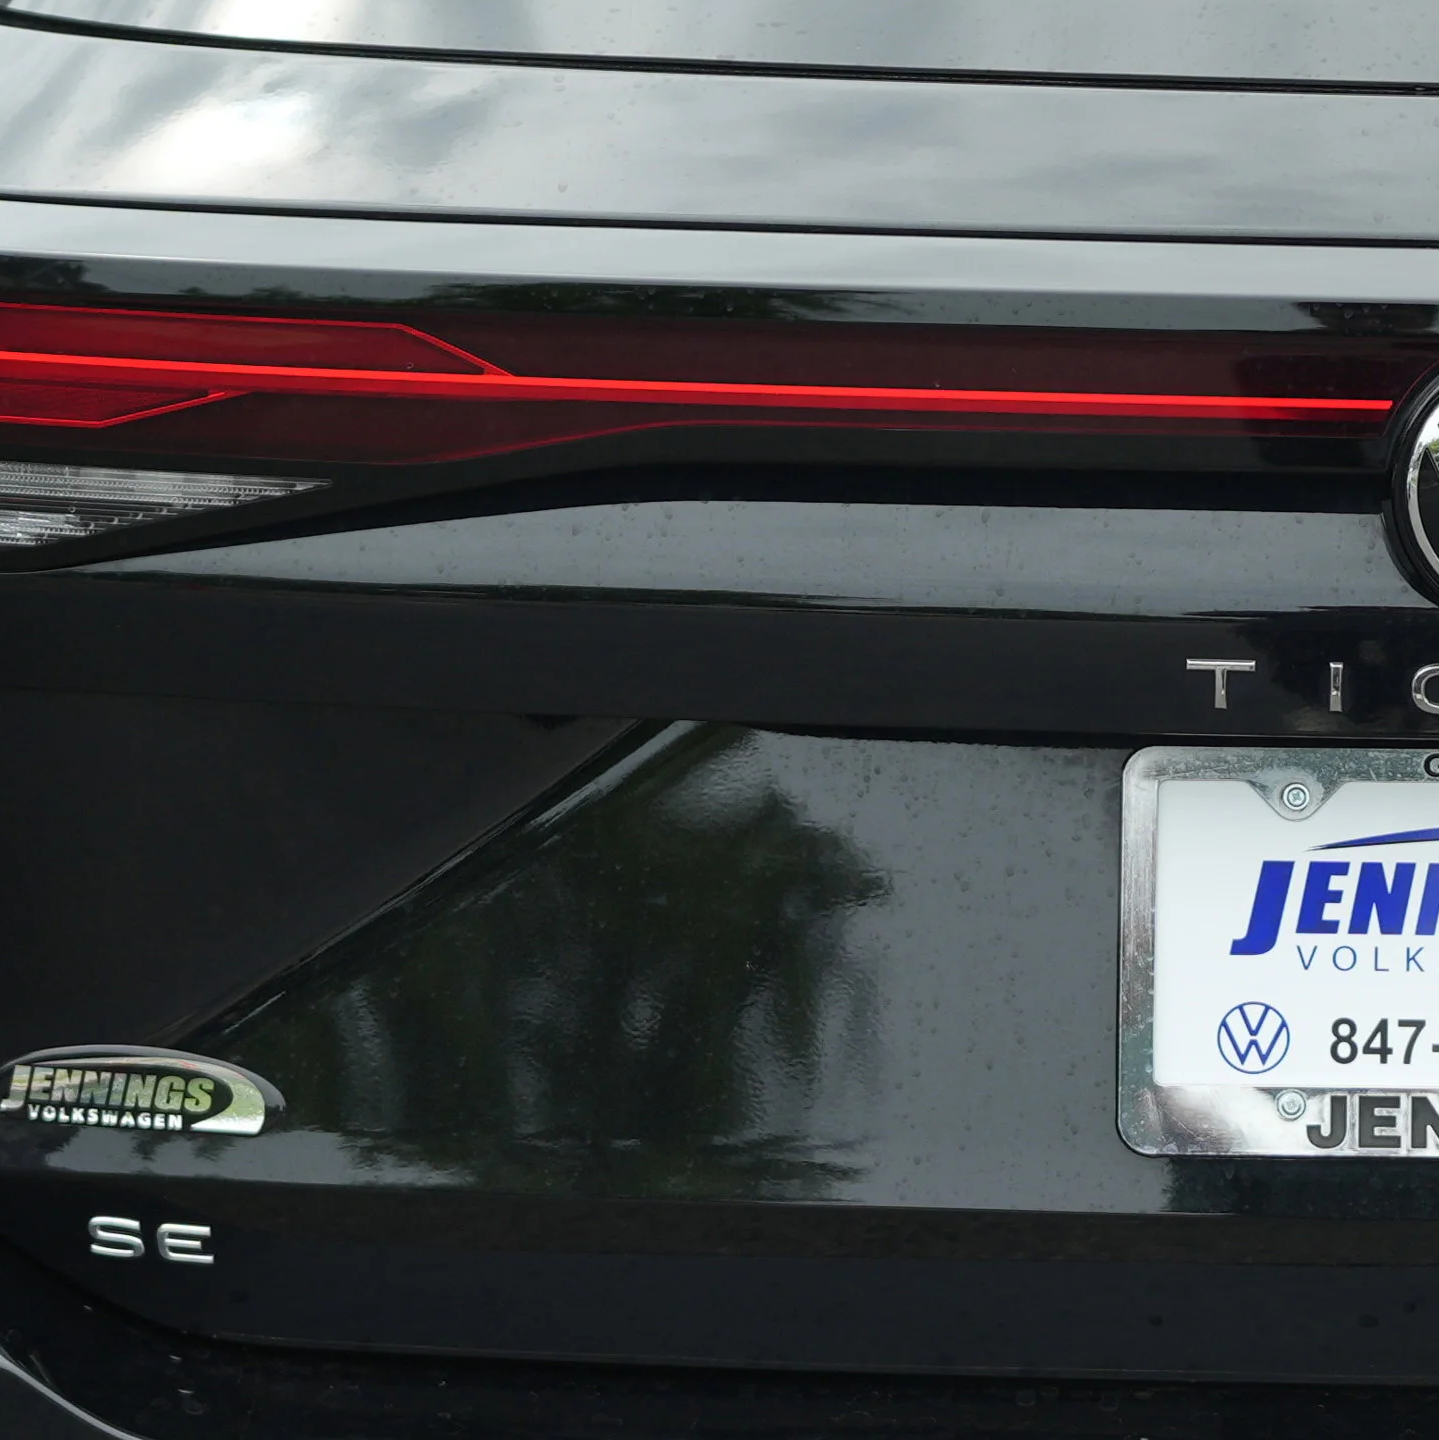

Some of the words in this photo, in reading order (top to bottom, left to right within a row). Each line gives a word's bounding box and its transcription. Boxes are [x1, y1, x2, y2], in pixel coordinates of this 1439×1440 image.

[0, 1064, 215, 1112] JENNINGS
[27, 1104, 184, 1131] VOLKSWAGEN
[87, 1215, 215, 1264] SE
